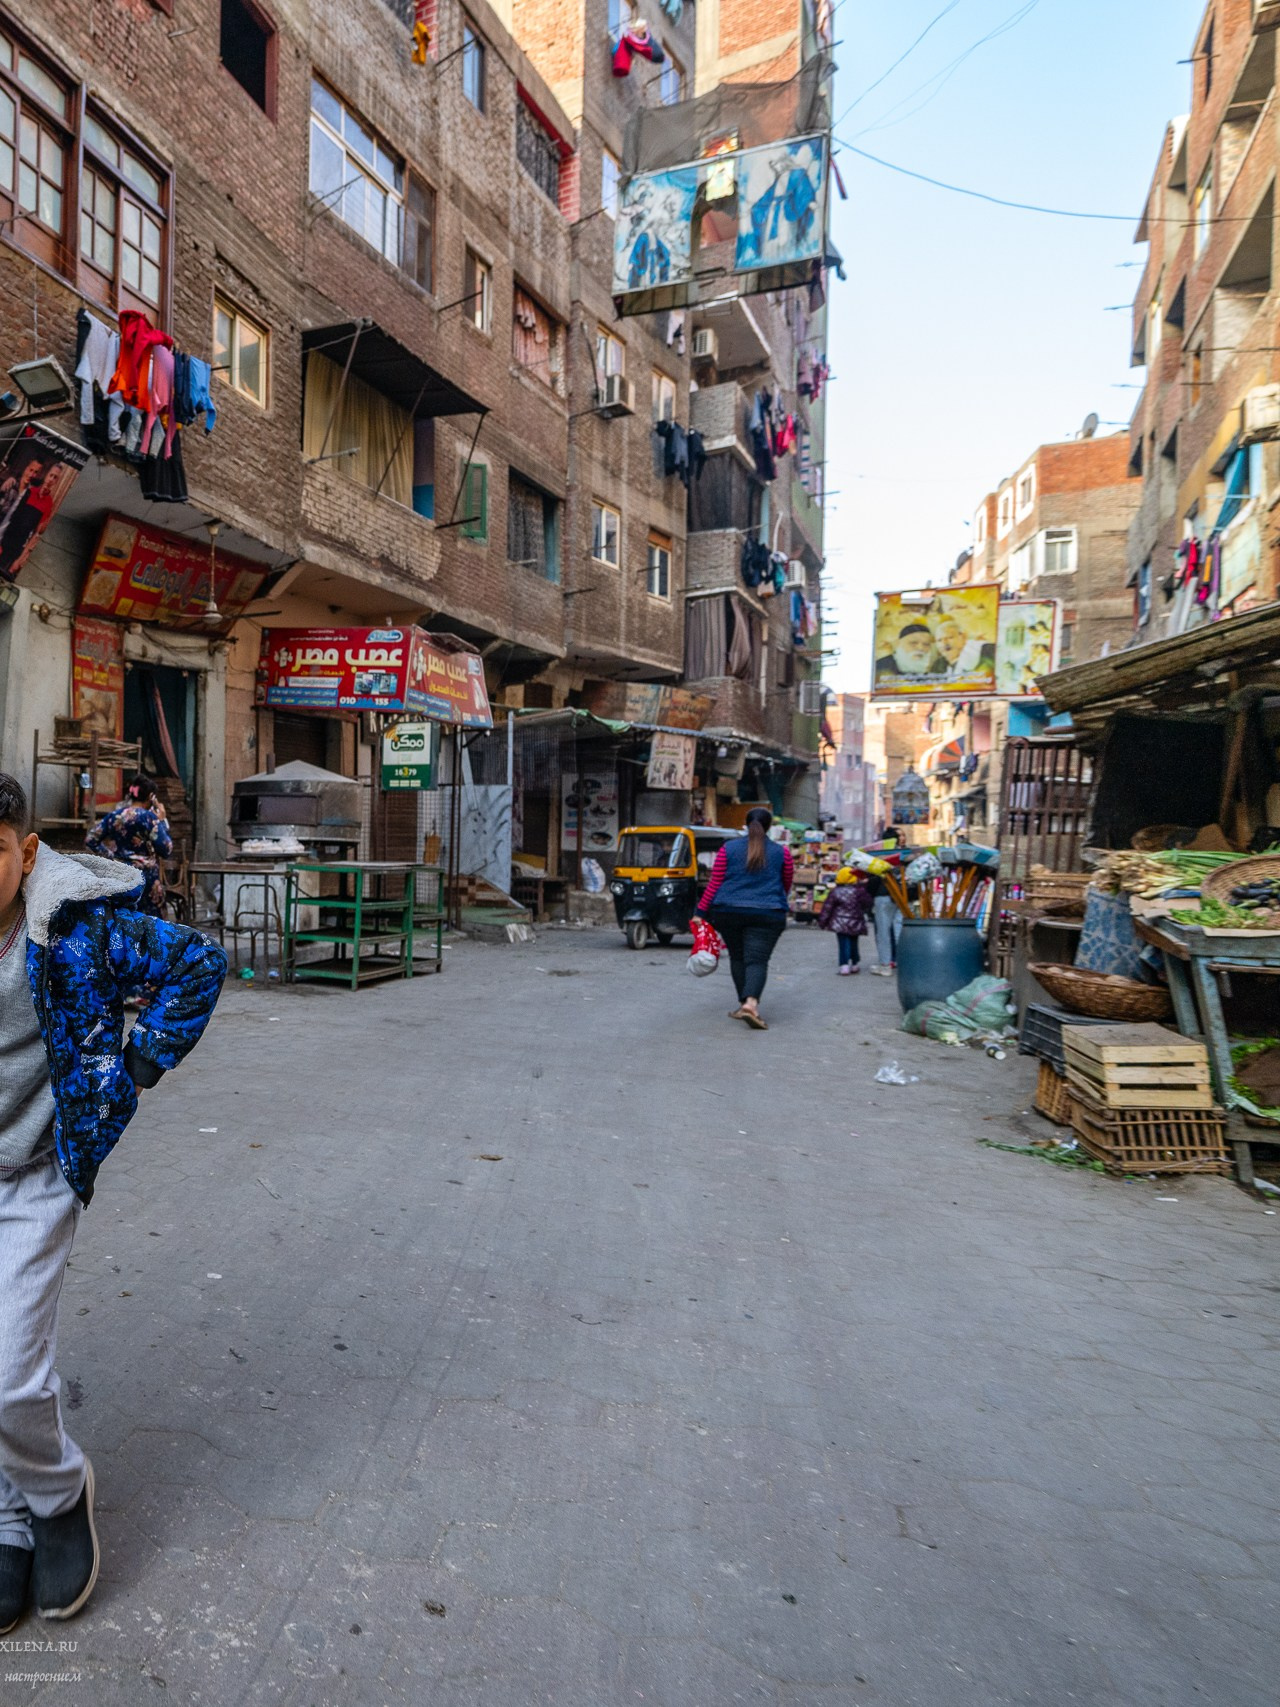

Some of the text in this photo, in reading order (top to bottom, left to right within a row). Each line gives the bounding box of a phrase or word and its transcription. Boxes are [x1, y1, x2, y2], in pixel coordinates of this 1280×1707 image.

[291, 648, 403, 673] عصب مصر
[392, 734, 424, 750] ممكن
[394, 766, 417, 777] 16379
